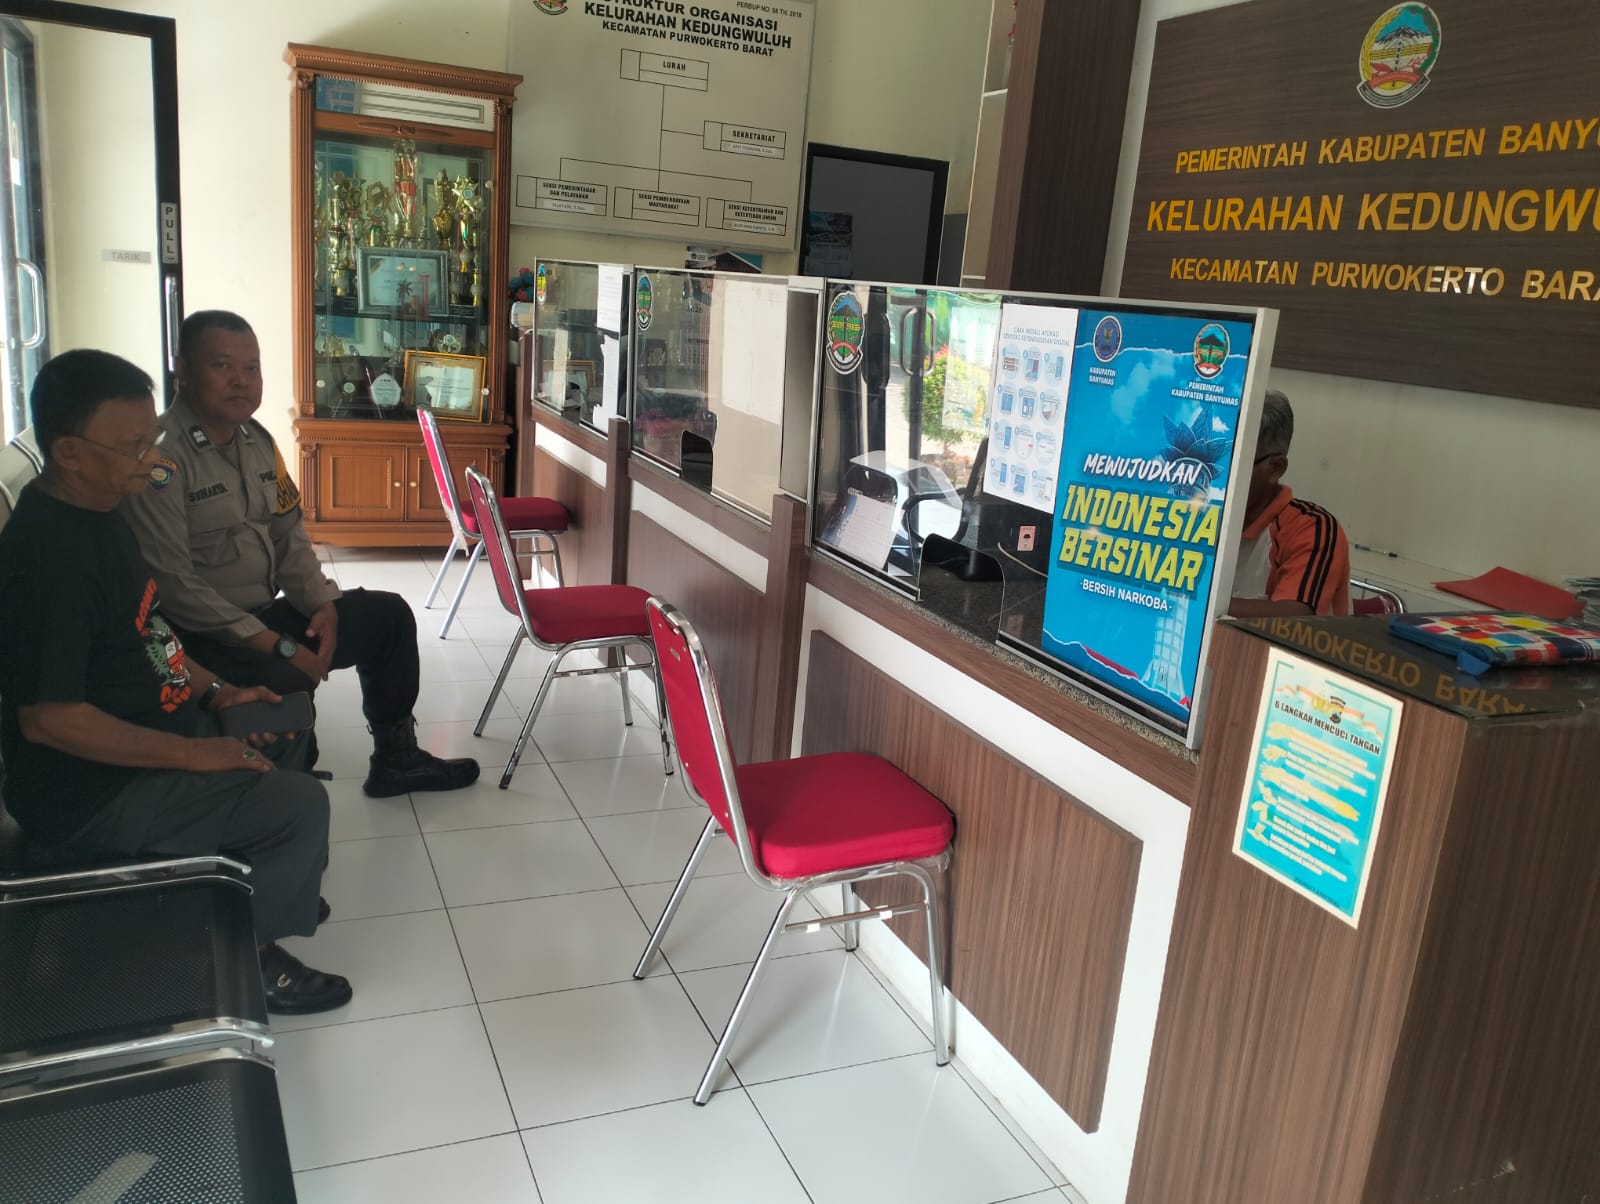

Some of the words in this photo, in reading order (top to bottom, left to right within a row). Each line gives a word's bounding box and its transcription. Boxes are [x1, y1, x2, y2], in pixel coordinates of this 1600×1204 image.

[585, 1, 677, 29] KELURAHAN
[681, 18, 791, 48] KEDUNGWULUH
[603, 0, 685, 15] UKTUR
[689, 6, 778, 31] ORGANISASI
[602, 20, 666, 39] KECAMATAN
[669, 31, 740, 51] PURWOKERTO
[742, 44, 774, 57] BARAT
[662, 61, 686, 71] LURAH
[732, 130, 776, 142] SEKRETARIAT
[1175, 140, 1307, 174] PEMERINTAH
[1318, 127, 1486, 164] KABUPATEN
[1498, 117, 1600, 155] BANY
[1147, 193, 1344, 232] KELURAHAN
[1357, 187, 1600, 232] KEDUNGW
[165, 206, 174, 253] PULL
[1169, 257, 1299, 286] KECAMATAN
[1311, 261, 1505, 297] PURWOKERTO
[1520, 268, 1600, 302] BAR
[1088, 375, 1115, 386] BANYUMAS
[1089, 367, 1116, 377] KABUPATEN
[1188, 381, 1225, 394] PEMERINTAH
[1171, 388, 1204, 401] KABUPATEN
[1204, 393, 1239, 407] BANYUMAS
[1083, 452, 1201, 485] MEWUJUDKAN
[1062, 484, 1221, 547] INDONESIA
[1059, 526, 1204, 592] BERSINAR
[1280, 702, 1313, 724] LANGKAH
[1314, 718, 1348, 740] MENCUCI
[1349, 733, 1380, 755] TANGAN
